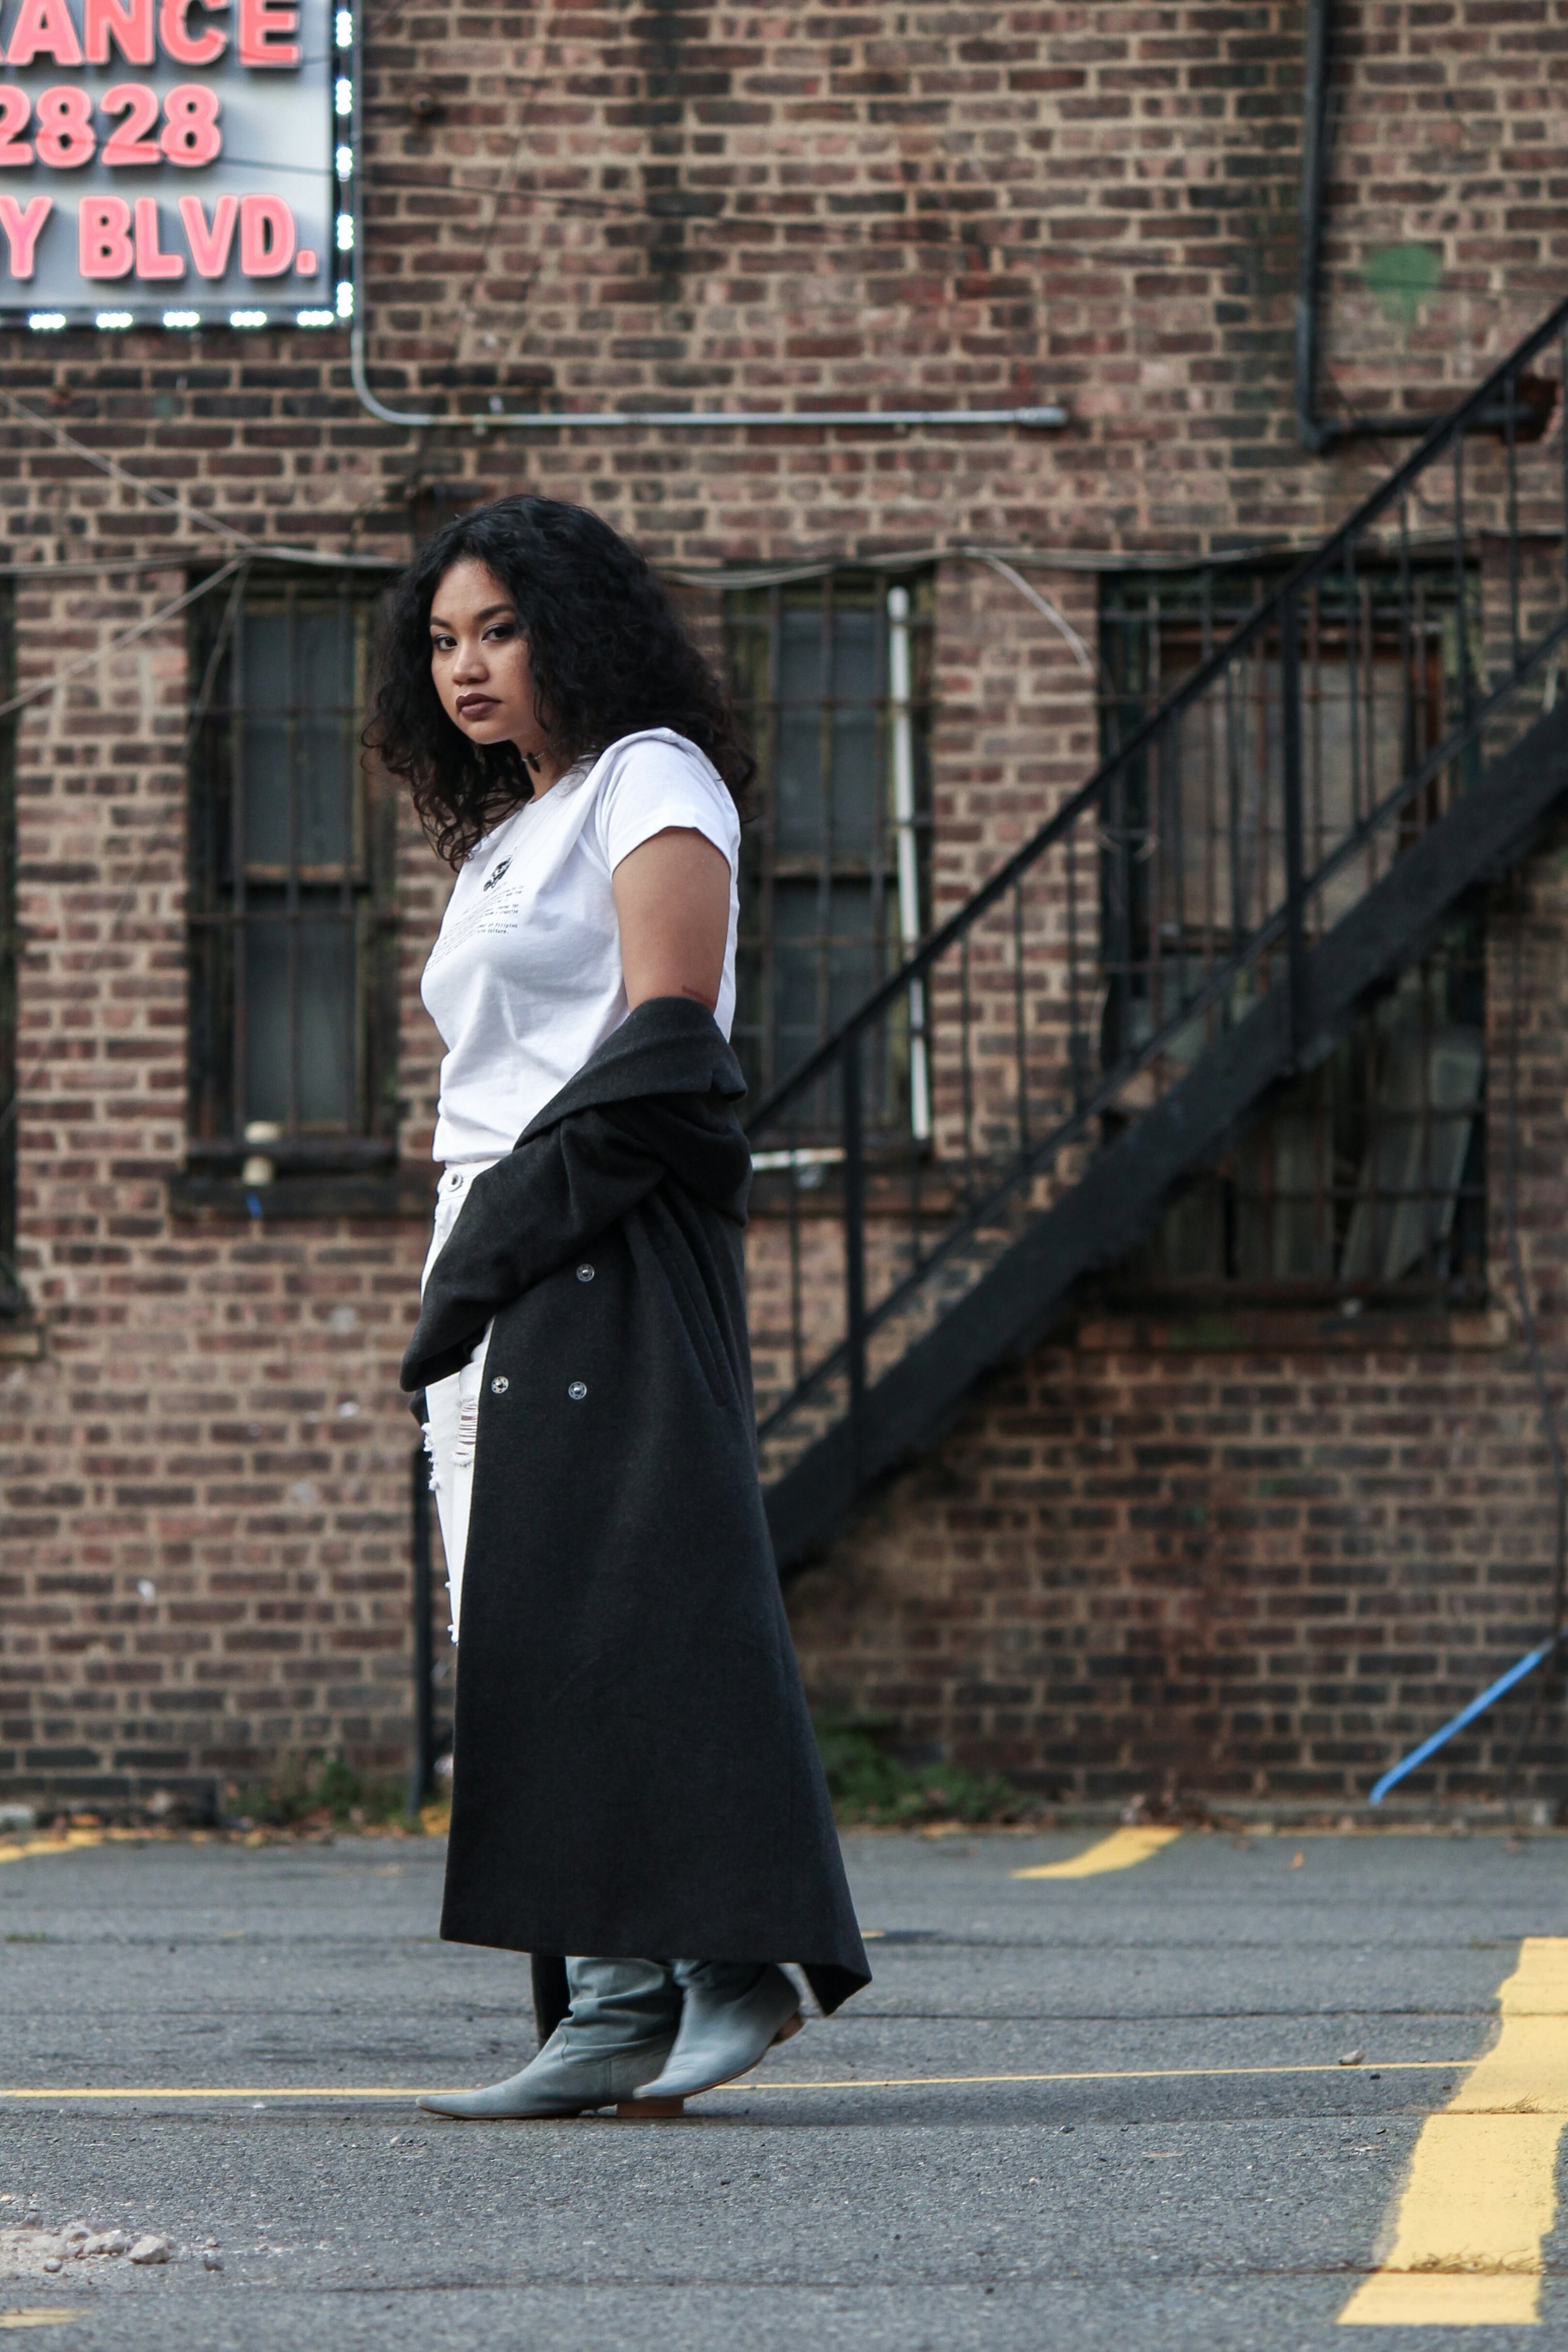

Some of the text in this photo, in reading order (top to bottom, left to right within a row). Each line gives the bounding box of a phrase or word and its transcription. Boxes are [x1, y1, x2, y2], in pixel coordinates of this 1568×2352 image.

[0, 0, 300, 65] ANCE
[0, 83, 221, 167] 2828
[78, 193, 317, 278] BLVD.
